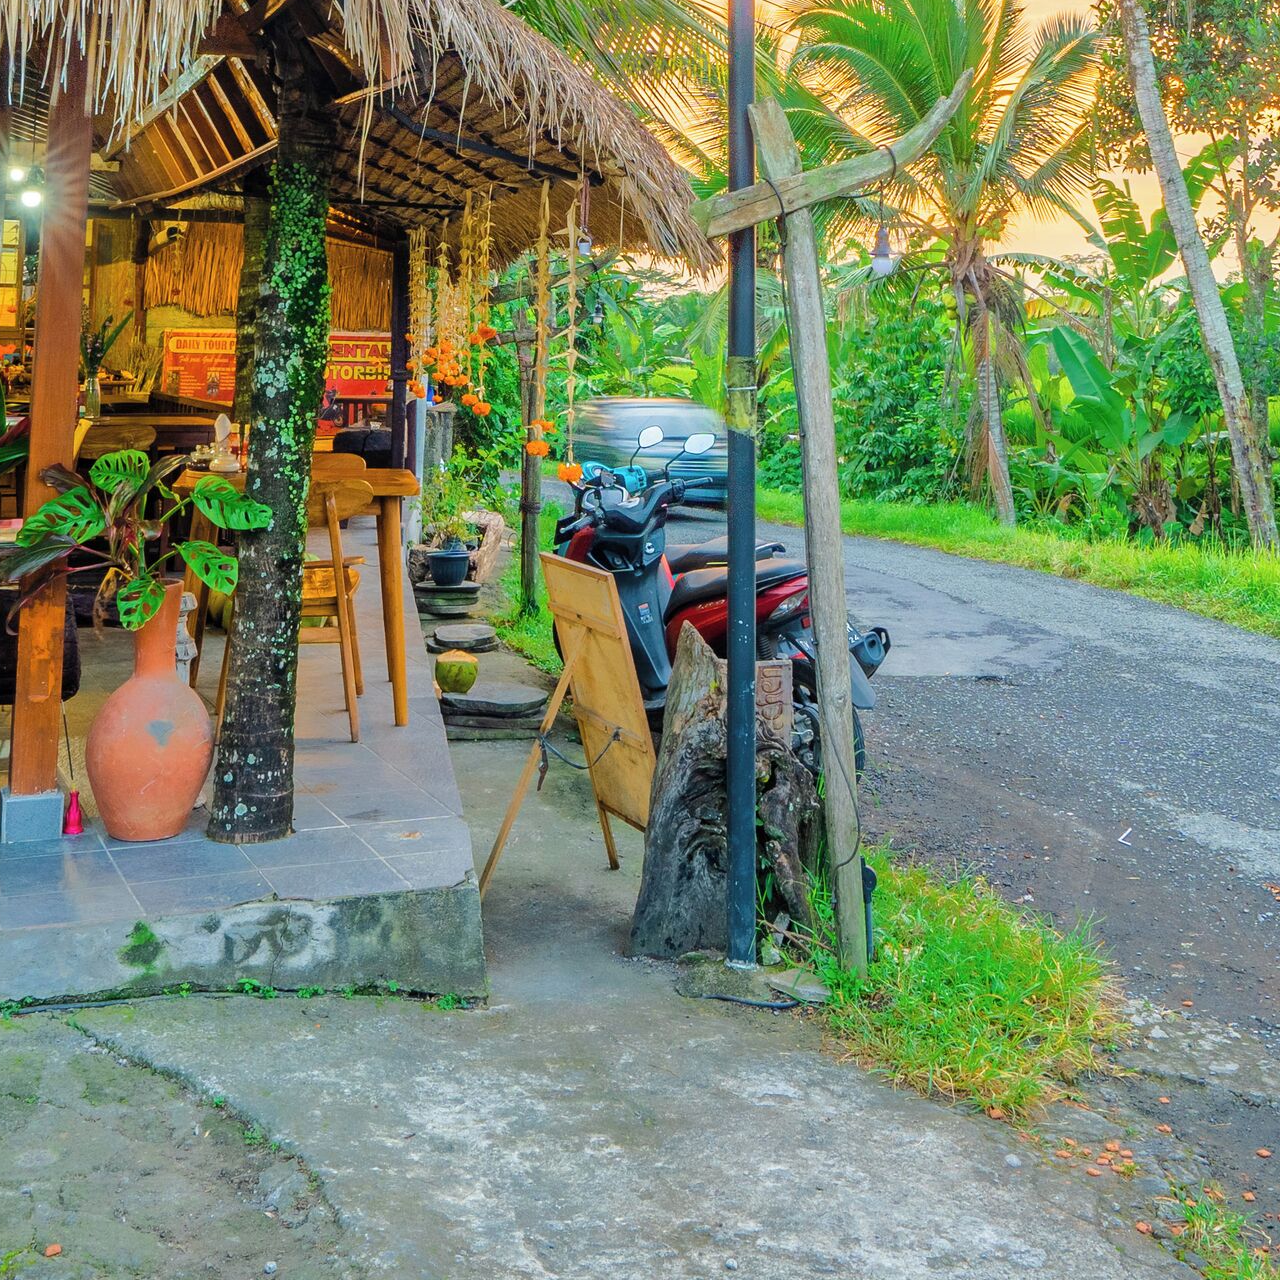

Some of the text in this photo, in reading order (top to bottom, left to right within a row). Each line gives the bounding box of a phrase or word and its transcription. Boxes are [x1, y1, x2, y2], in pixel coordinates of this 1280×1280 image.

[176, 339, 200, 350] DAILY
[203, 340, 227, 351] TOUR
[330, 343, 389, 358] ENTAL
